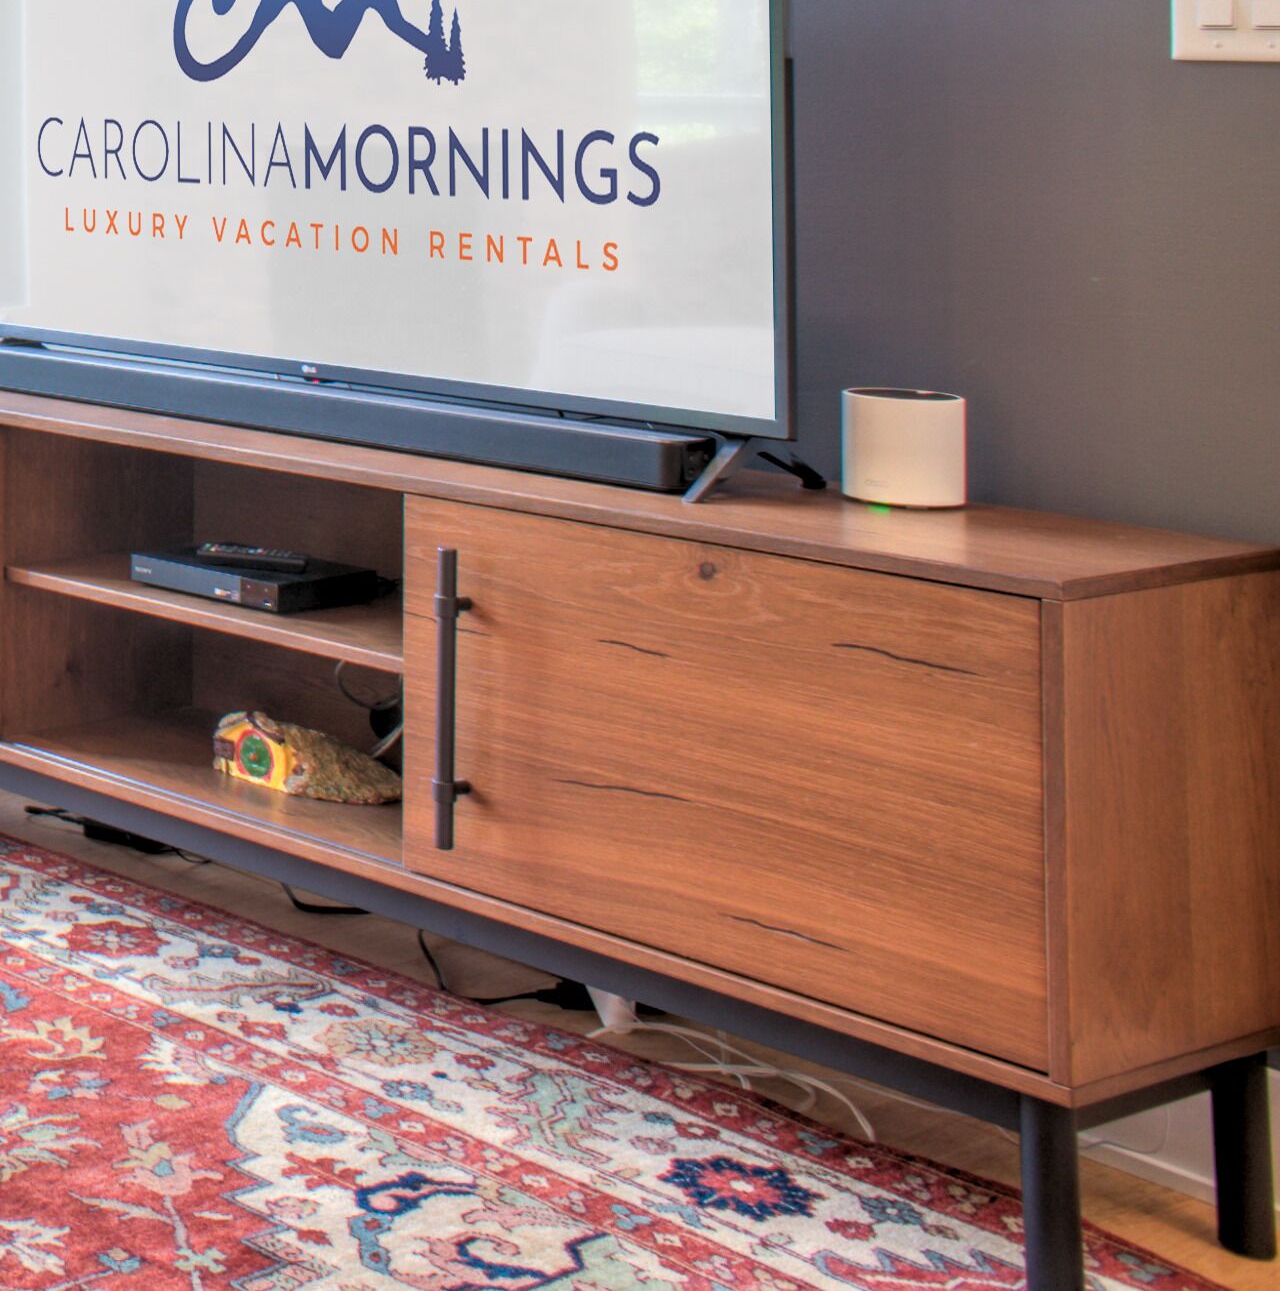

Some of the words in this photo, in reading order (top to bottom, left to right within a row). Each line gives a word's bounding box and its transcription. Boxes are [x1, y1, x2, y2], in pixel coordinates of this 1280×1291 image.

[37, 116, 662, 208] CAROLINAMORNINGS
[64, 206, 189, 242] LUXURY
[211, 215, 400, 257] VACATION
[429, 228, 621, 273] RENTALS
